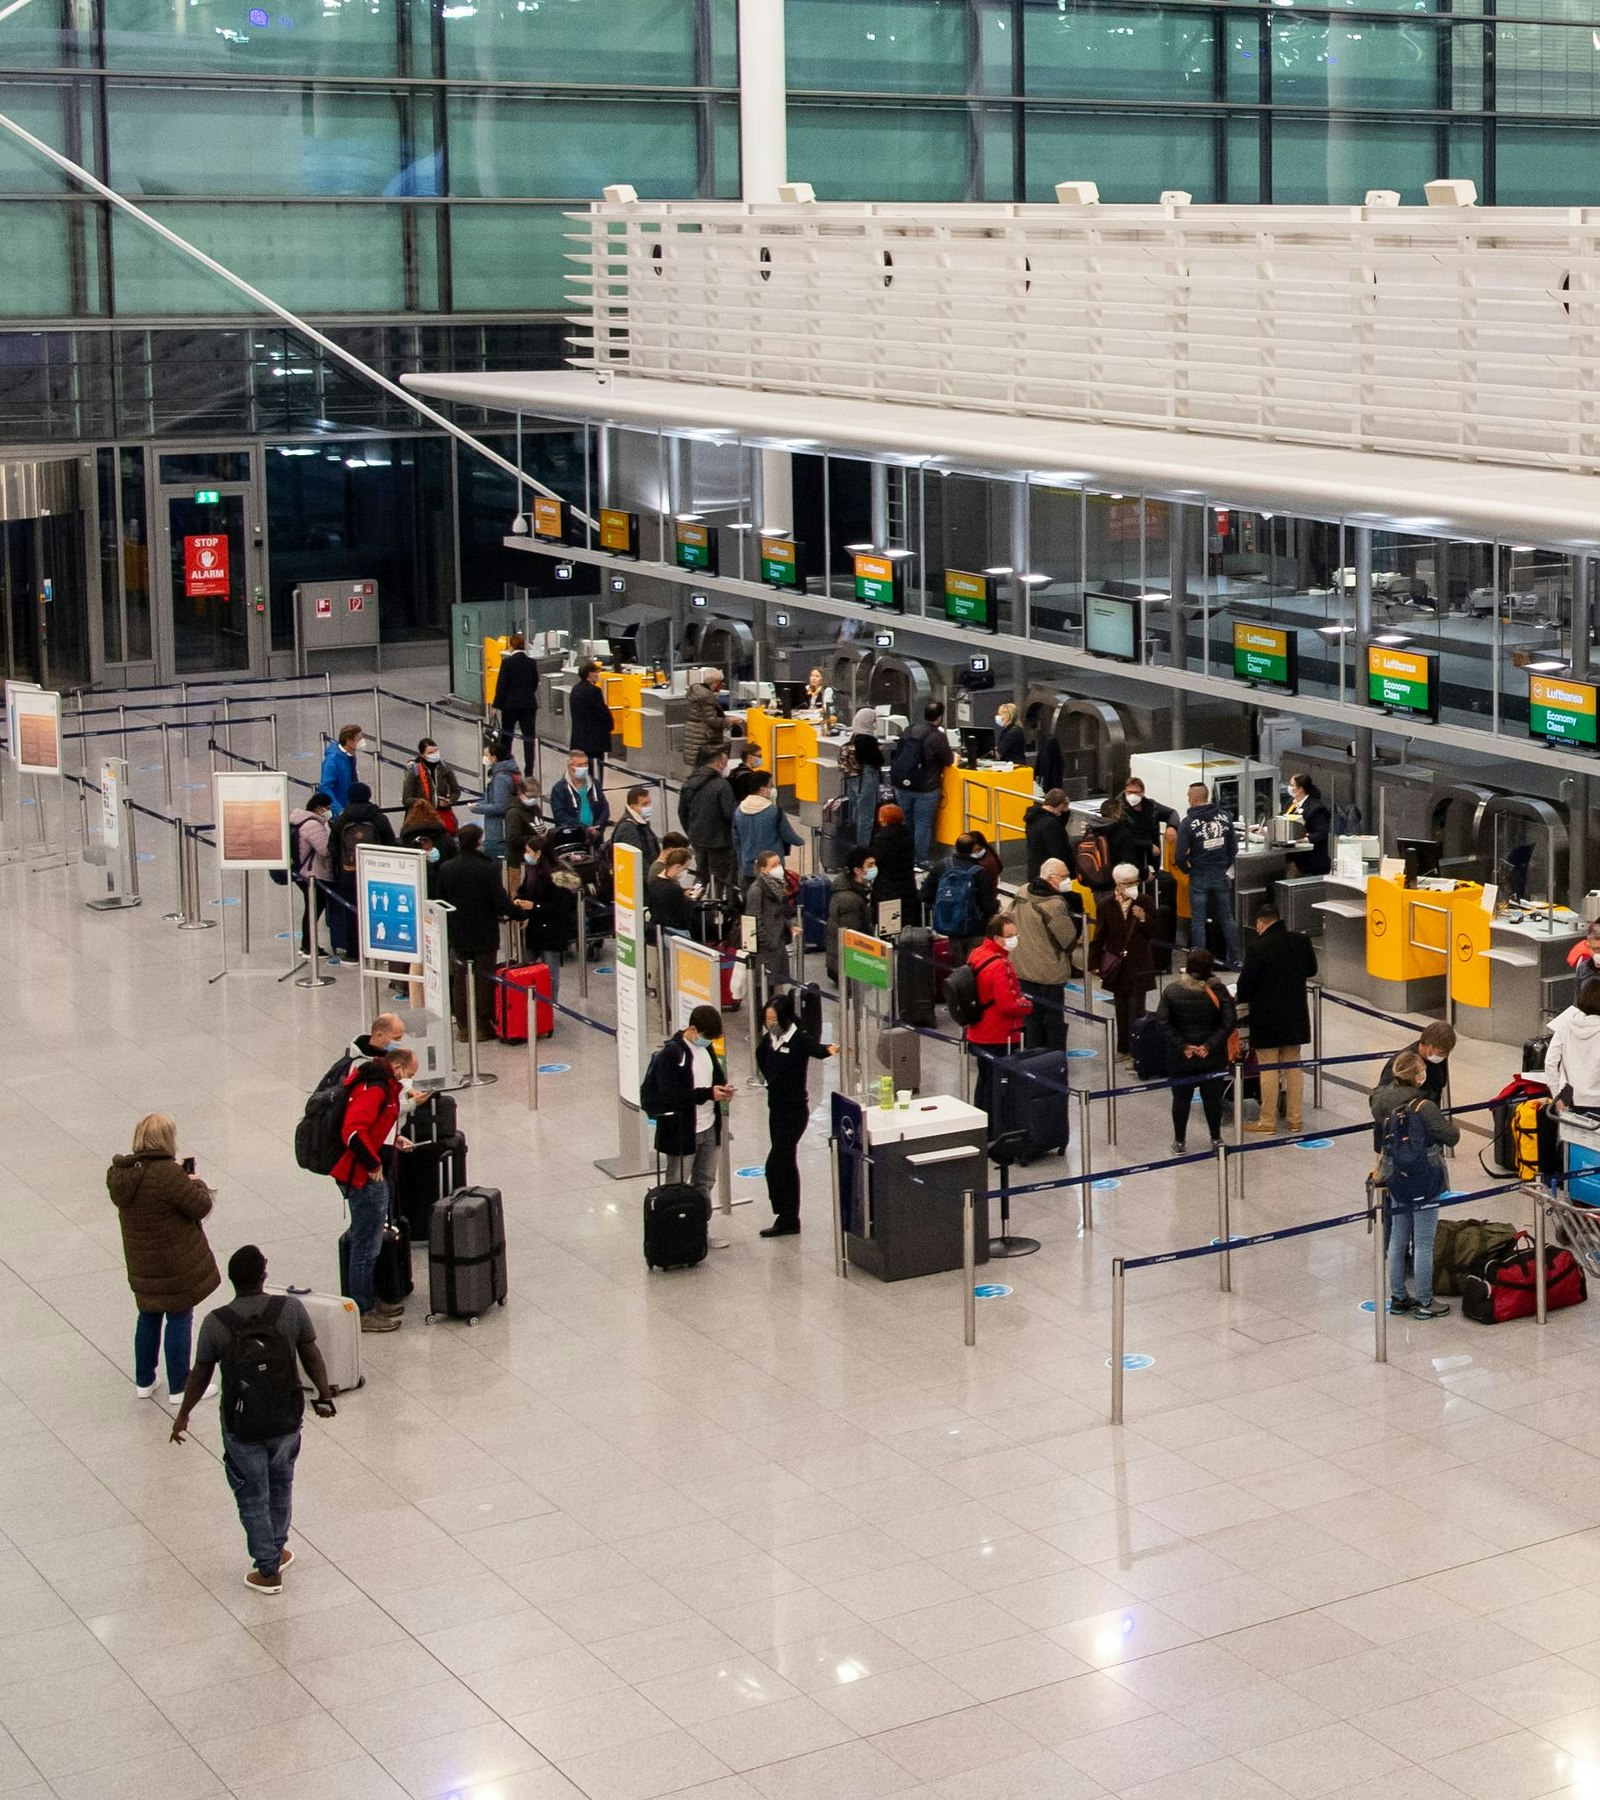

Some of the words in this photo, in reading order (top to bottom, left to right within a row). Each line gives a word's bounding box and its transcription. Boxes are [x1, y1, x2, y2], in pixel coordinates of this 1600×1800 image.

[195, 538, 218, 547] STOP
[192, 569, 224, 579] ALARM
[973, 658, 984, 669] 21
[1247, 653, 1272, 667] Economy
[1383, 657, 1417, 674] Lufthansa
[1247, 663, 1262, 674] Class
[1383, 679, 1411, 695] Economy
[1383, 689, 1400, 701] Class
[1546, 687, 1583, 705] Lufthansa
[1546, 710, 1577, 727] Economy
[1546, 720, 1565, 733] Class
